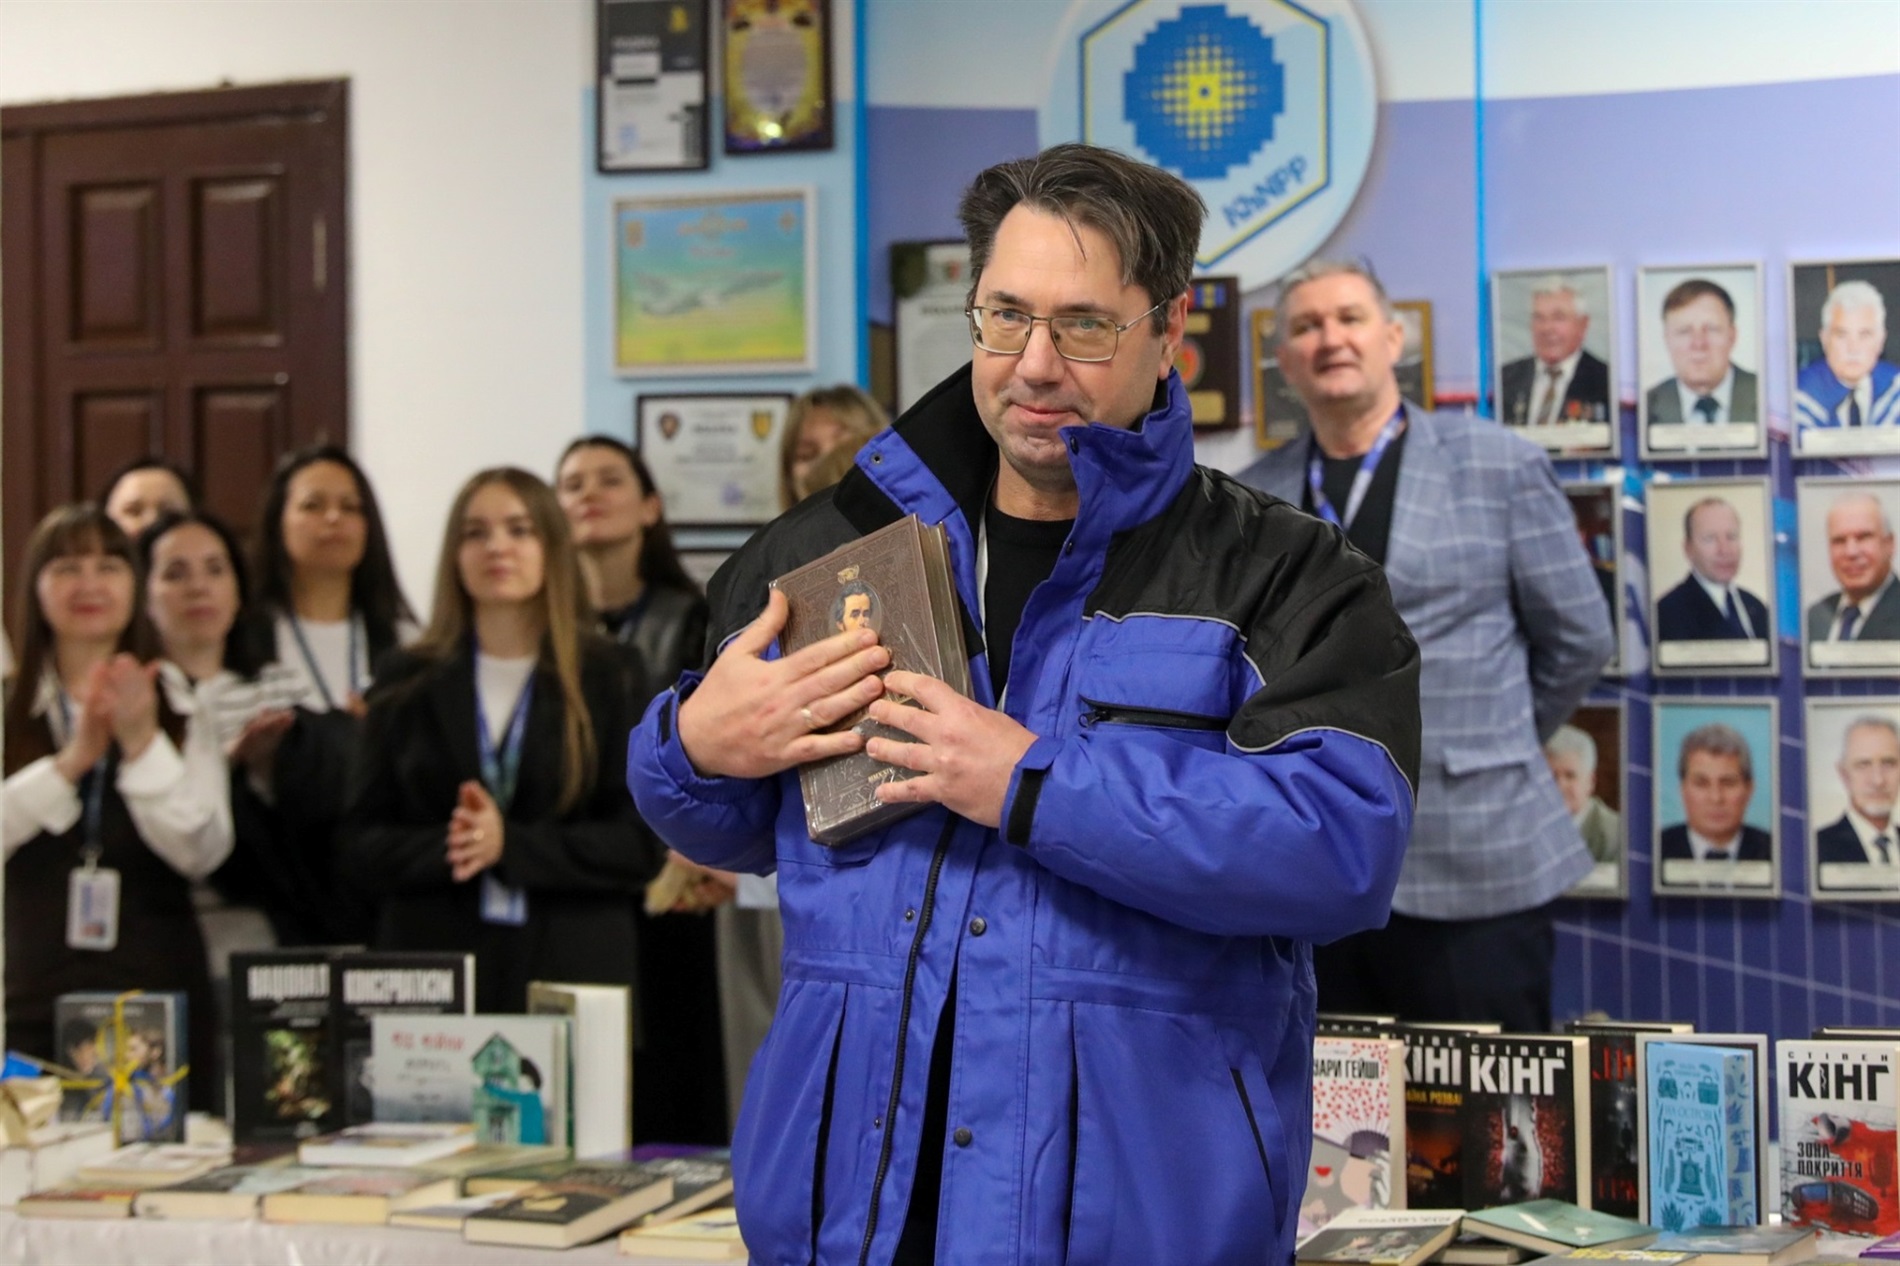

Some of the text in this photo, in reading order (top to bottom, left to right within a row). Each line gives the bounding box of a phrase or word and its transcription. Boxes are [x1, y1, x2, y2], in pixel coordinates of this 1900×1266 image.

[1470, 1042, 1566, 1058] СТІВЕН
[1788, 1051, 1888, 1063] СТІВЕН
[1469, 1054, 1567, 1097] КІНГ
[1788, 1061, 1890, 1102] КІНГ
[1797, 1141, 1830, 1159] ЗОНА
[1797, 1160, 1864, 1179] ПОКРИТТЯ
